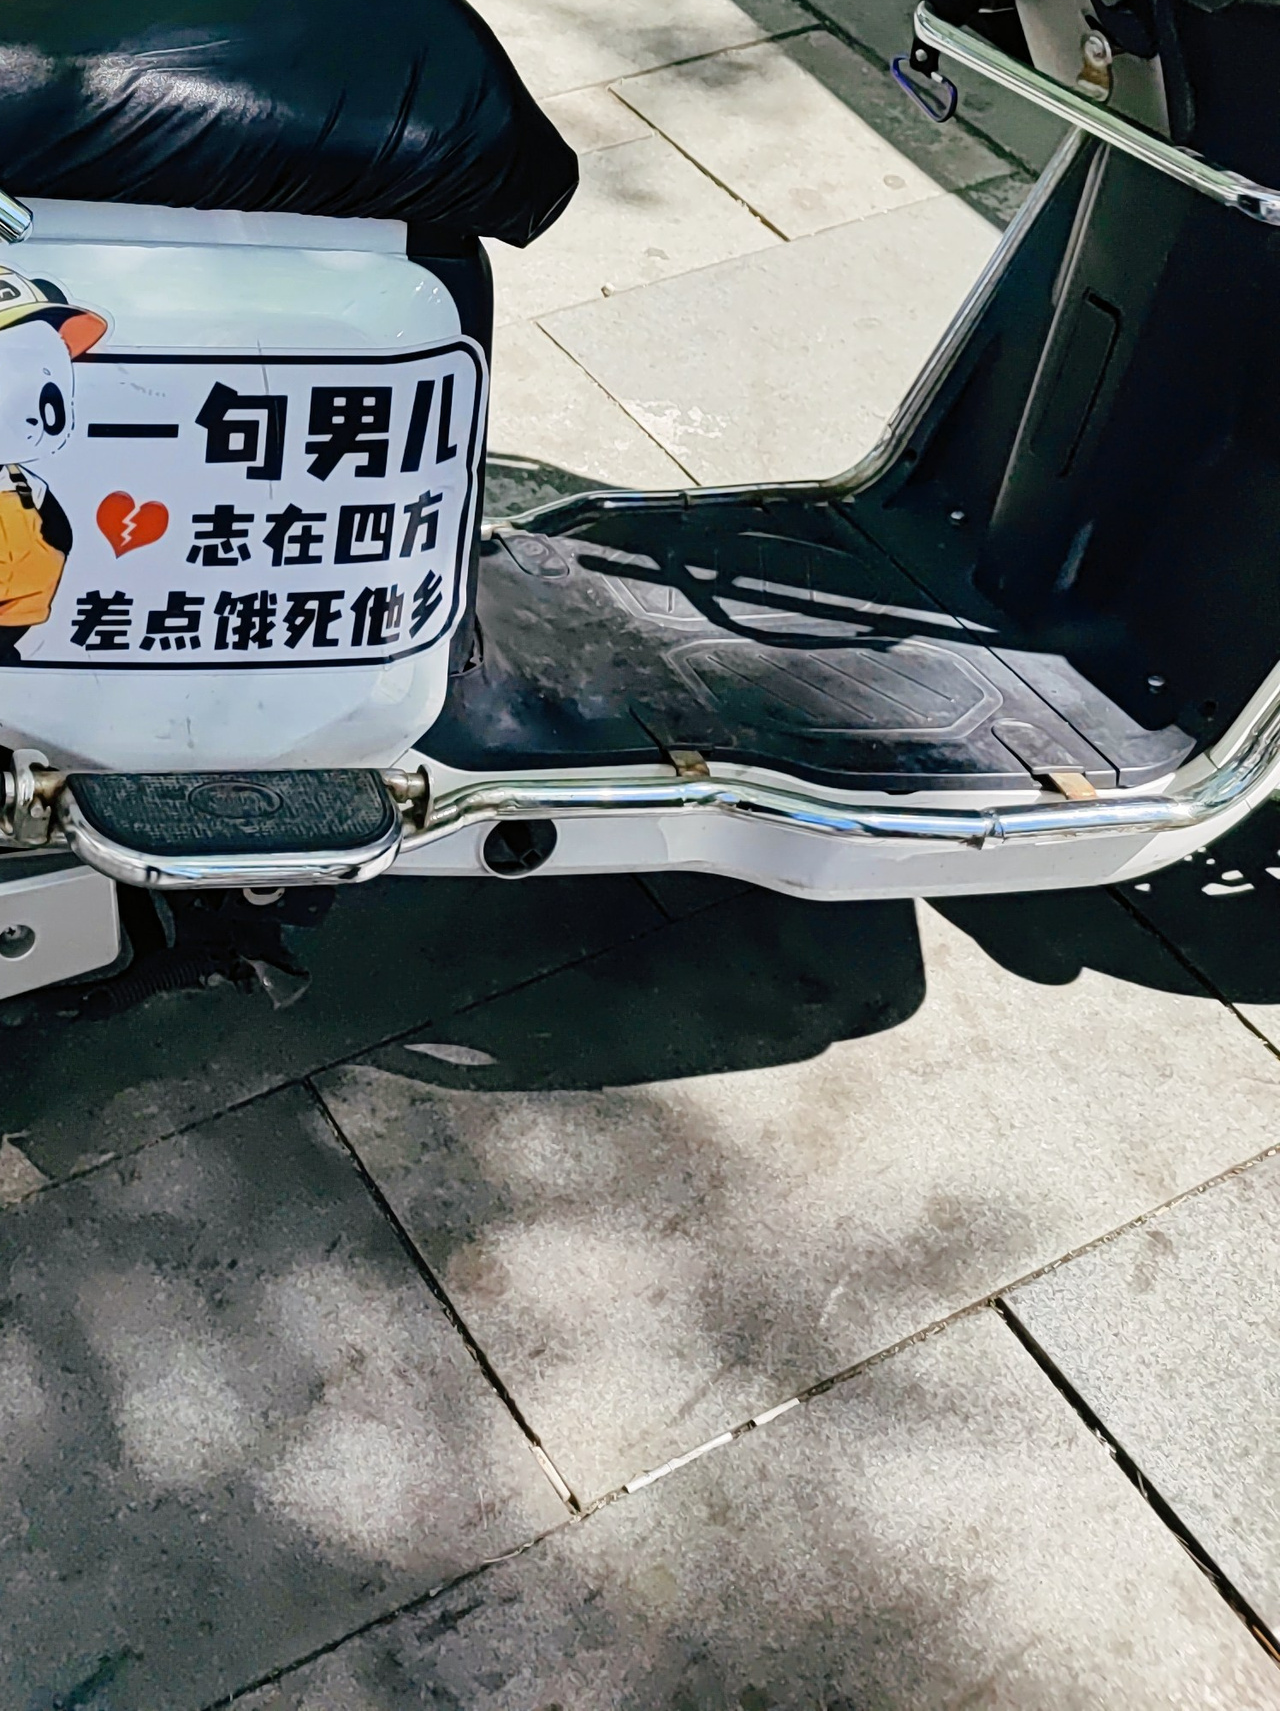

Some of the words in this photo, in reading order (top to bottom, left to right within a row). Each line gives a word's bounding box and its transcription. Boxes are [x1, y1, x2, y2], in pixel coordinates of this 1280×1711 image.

[87, 373, 458, 480] 一句男儿
[185, 490, 443, 567] 志在四方
[70, 570, 444, 651] 差点饿死他乡
